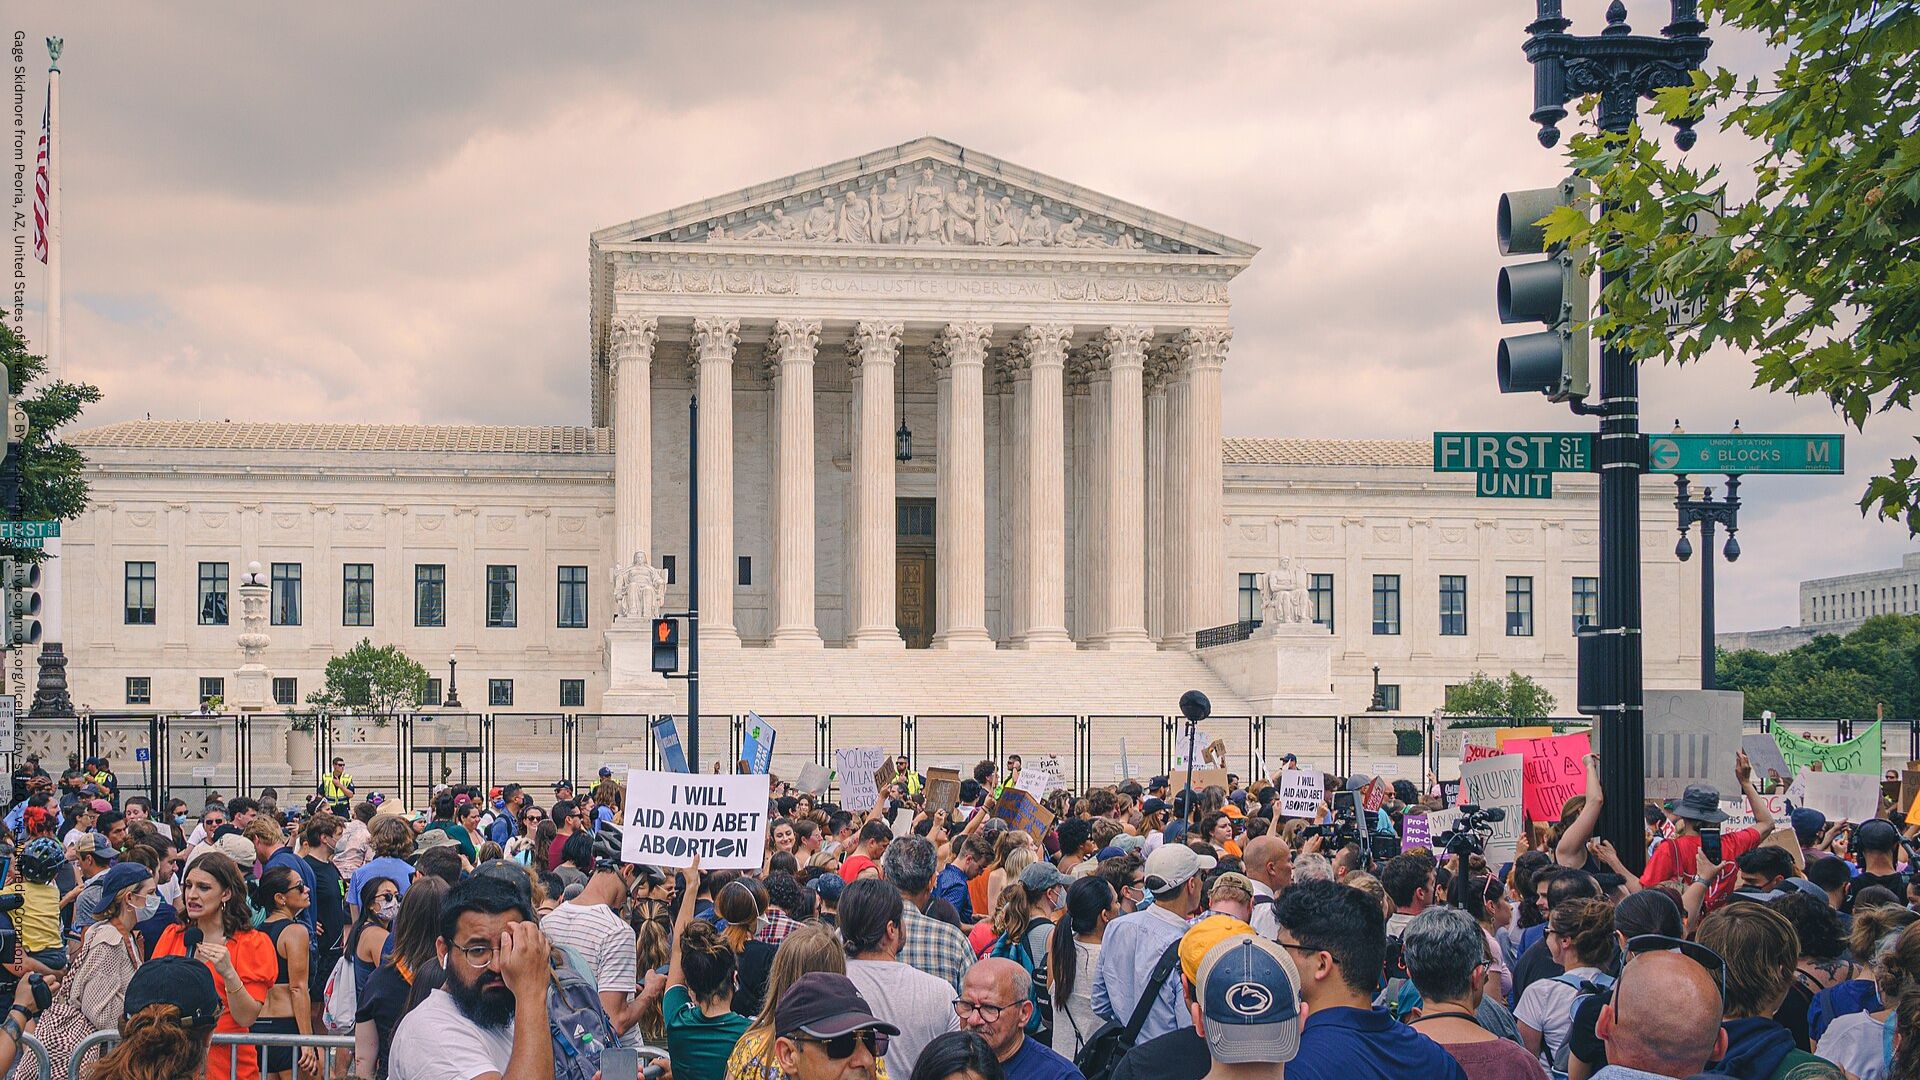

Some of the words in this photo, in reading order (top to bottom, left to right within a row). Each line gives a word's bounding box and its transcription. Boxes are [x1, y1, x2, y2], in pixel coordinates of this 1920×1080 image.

[811, 277, 869, 293] EQUAL
[872, 278, 938, 294] JUSTICE
[947, 280, 1001, 295] UNDER
[1009, 282, 1042, 296] LAW
[1709, 439, 1734, 447] UNION
[1737, 439, 1774, 447] STATION
[1440, 436, 1553, 469] FIRST
[1560, 438, 1582, 452] ST
[1700, 448, 1709, 462] 6
[1718, 449, 1782, 463] BLOCKS
[1806, 441, 1830, 462] M
[1559, 454, 1585, 469] NE
[1481, 474, 1549, 497] UNIT
[0, 522, 46, 537] FIRST
[15, 538, 42, 548] UNIT
[840, 748, 863, 769] YOU
[863, 750, 880, 761] ARE
[1469, 745, 1488, 758] YOU
[1488, 750, 1505, 758] CA
[864, 759, 879, 770] THE
[1040, 759, 1060, 769] FUCK
[1783, 751, 1862, 777] Abtion
[841, 769, 875, 786] VILLAI
[1297, 775, 1301, 786] I
[1301, 776, 1315, 787] WILL
[671, 785, 678, 805] I
[684, 785, 727, 806] WILL
[1283, 787, 1295, 798] AID
[1295, 788, 1309, 799] AND
[1309, 789, 1323, 800] ABET
[846, 795, 877, 810] HISTOR
[1285, 800, 1320, 812] ABORTION
[632, 808, 666, 829] AID
[669, 810, 708, 832] AND
[712, 812, 760, 833] ABET
[638, 833, 748, 859] ABORTION
